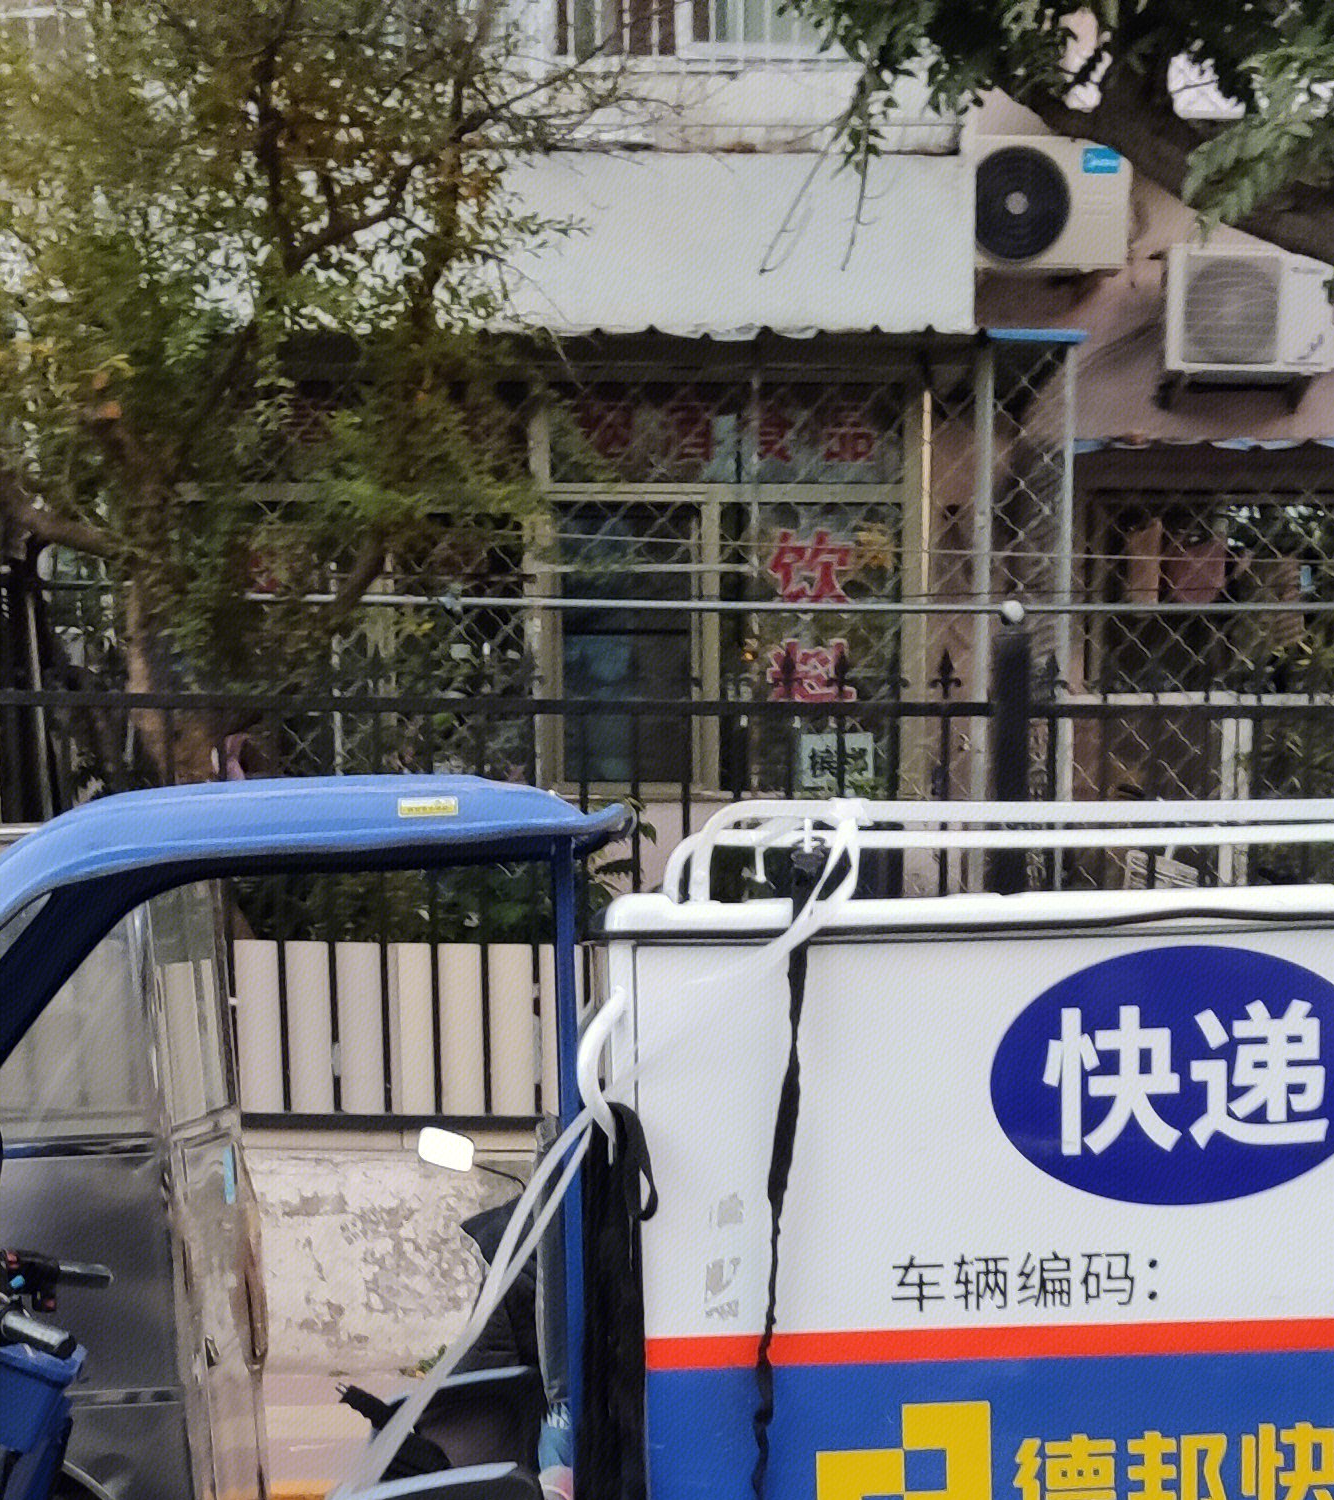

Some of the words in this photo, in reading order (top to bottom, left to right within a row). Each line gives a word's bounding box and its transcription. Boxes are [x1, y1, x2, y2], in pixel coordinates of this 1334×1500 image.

[1042, 997, 1329, 1156] 快递
[890, 1251, 1161, 1312] 车辆编码：
